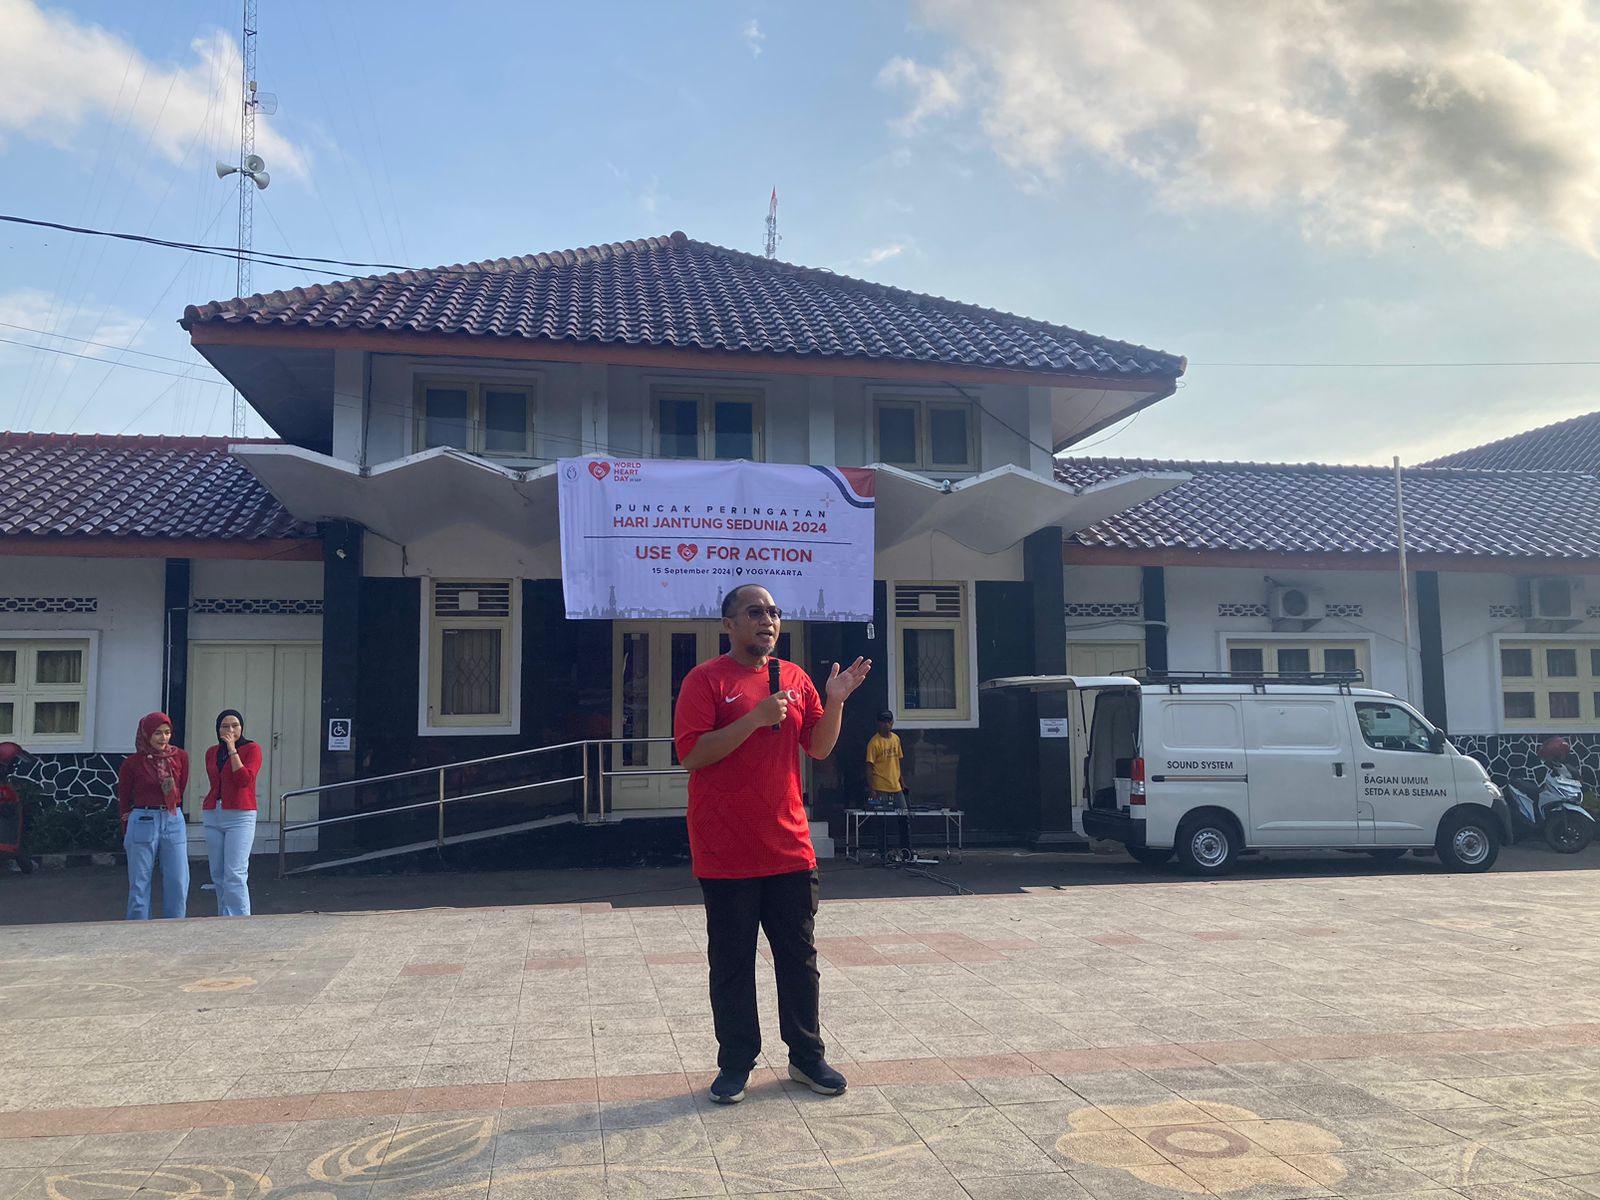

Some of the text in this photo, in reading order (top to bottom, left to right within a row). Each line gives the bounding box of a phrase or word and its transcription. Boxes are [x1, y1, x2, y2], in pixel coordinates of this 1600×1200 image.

[616, 504, 825, 518] PUNCAK PERINGATAN
[614, 516, 828, 533] HARI JANTUNG SEDUNIA 2024
[636, 546, 812, 562] USE FOR ACTION
[746, 568, 802, 576] YOGYAKARTA
[1167, 760, 1234, 770] SOUND SYSTEM
[1364, 776, 1428, 785] BAGIAN UMUM
[1364, 788, 1448, 797] SETDA KAB SLEMAN
